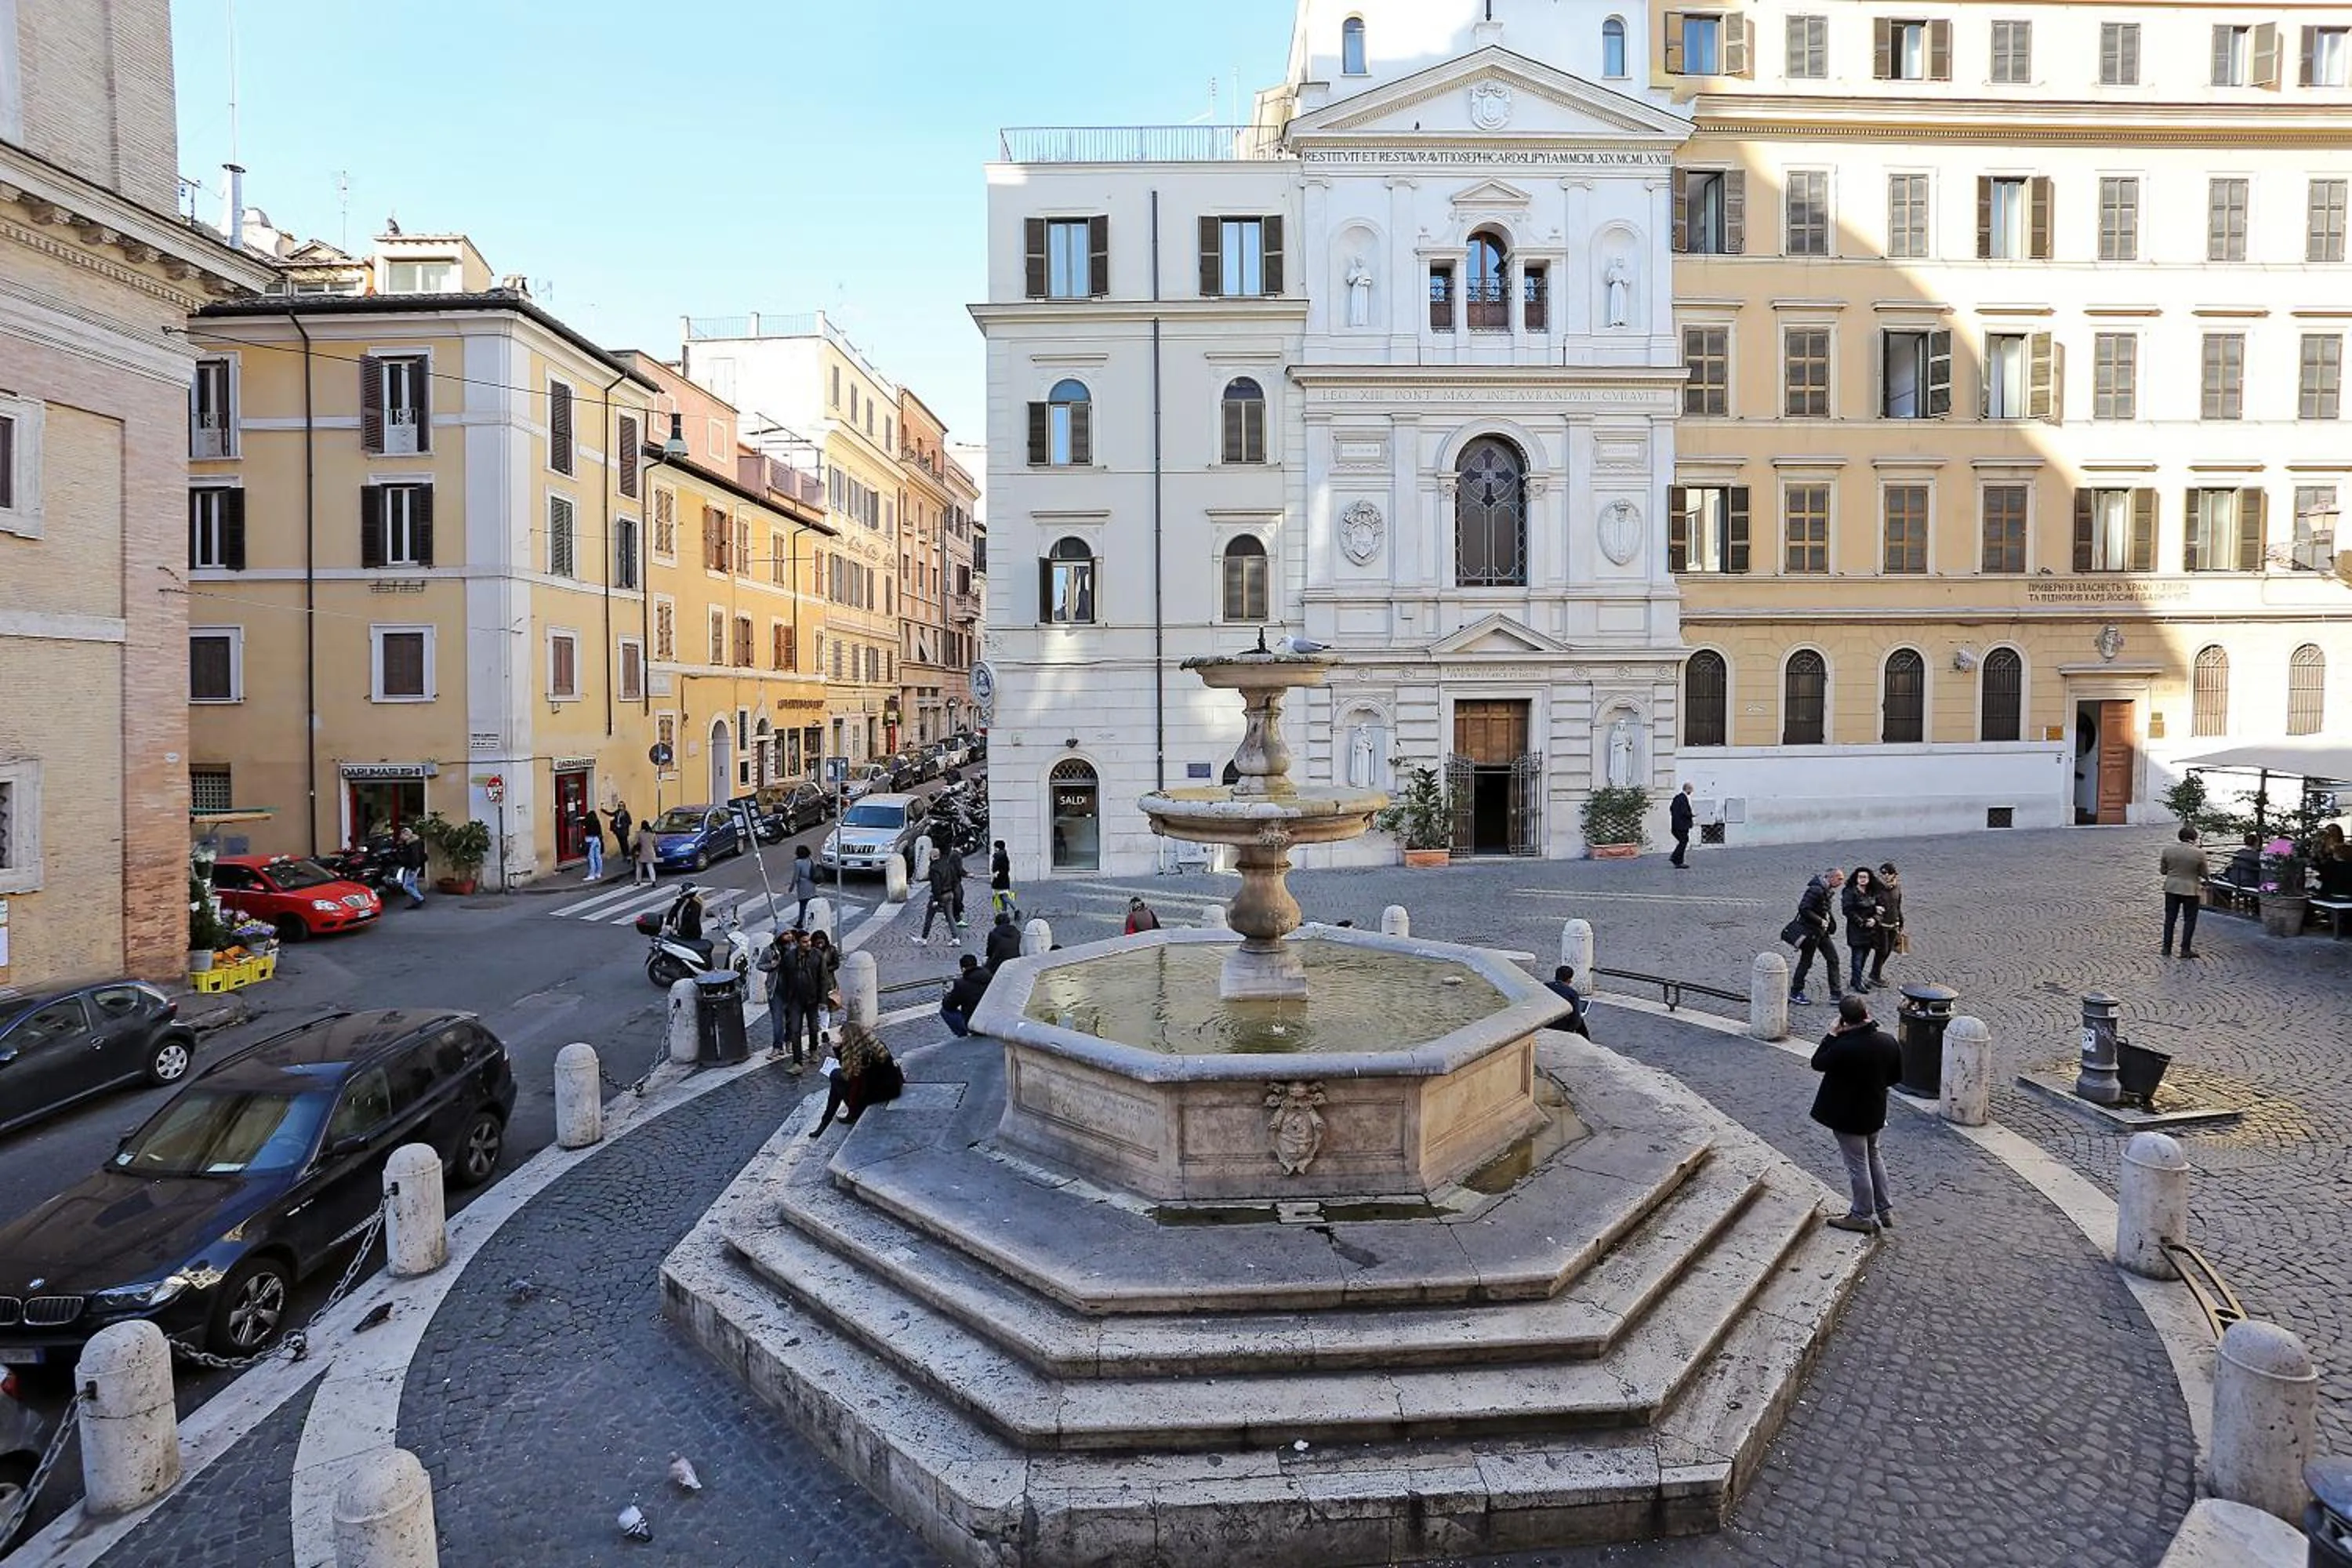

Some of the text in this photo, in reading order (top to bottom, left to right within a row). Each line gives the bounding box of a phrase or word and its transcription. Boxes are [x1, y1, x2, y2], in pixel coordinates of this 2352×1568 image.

[1362, 151, 1377, 162] ET
[1322, 390, 1348, 401] LEO
[1395, 390, 1431, 401] PONT
[1443, 390, 1475, 401] MAX
[1059, 796, 1087, 806] SALDI
